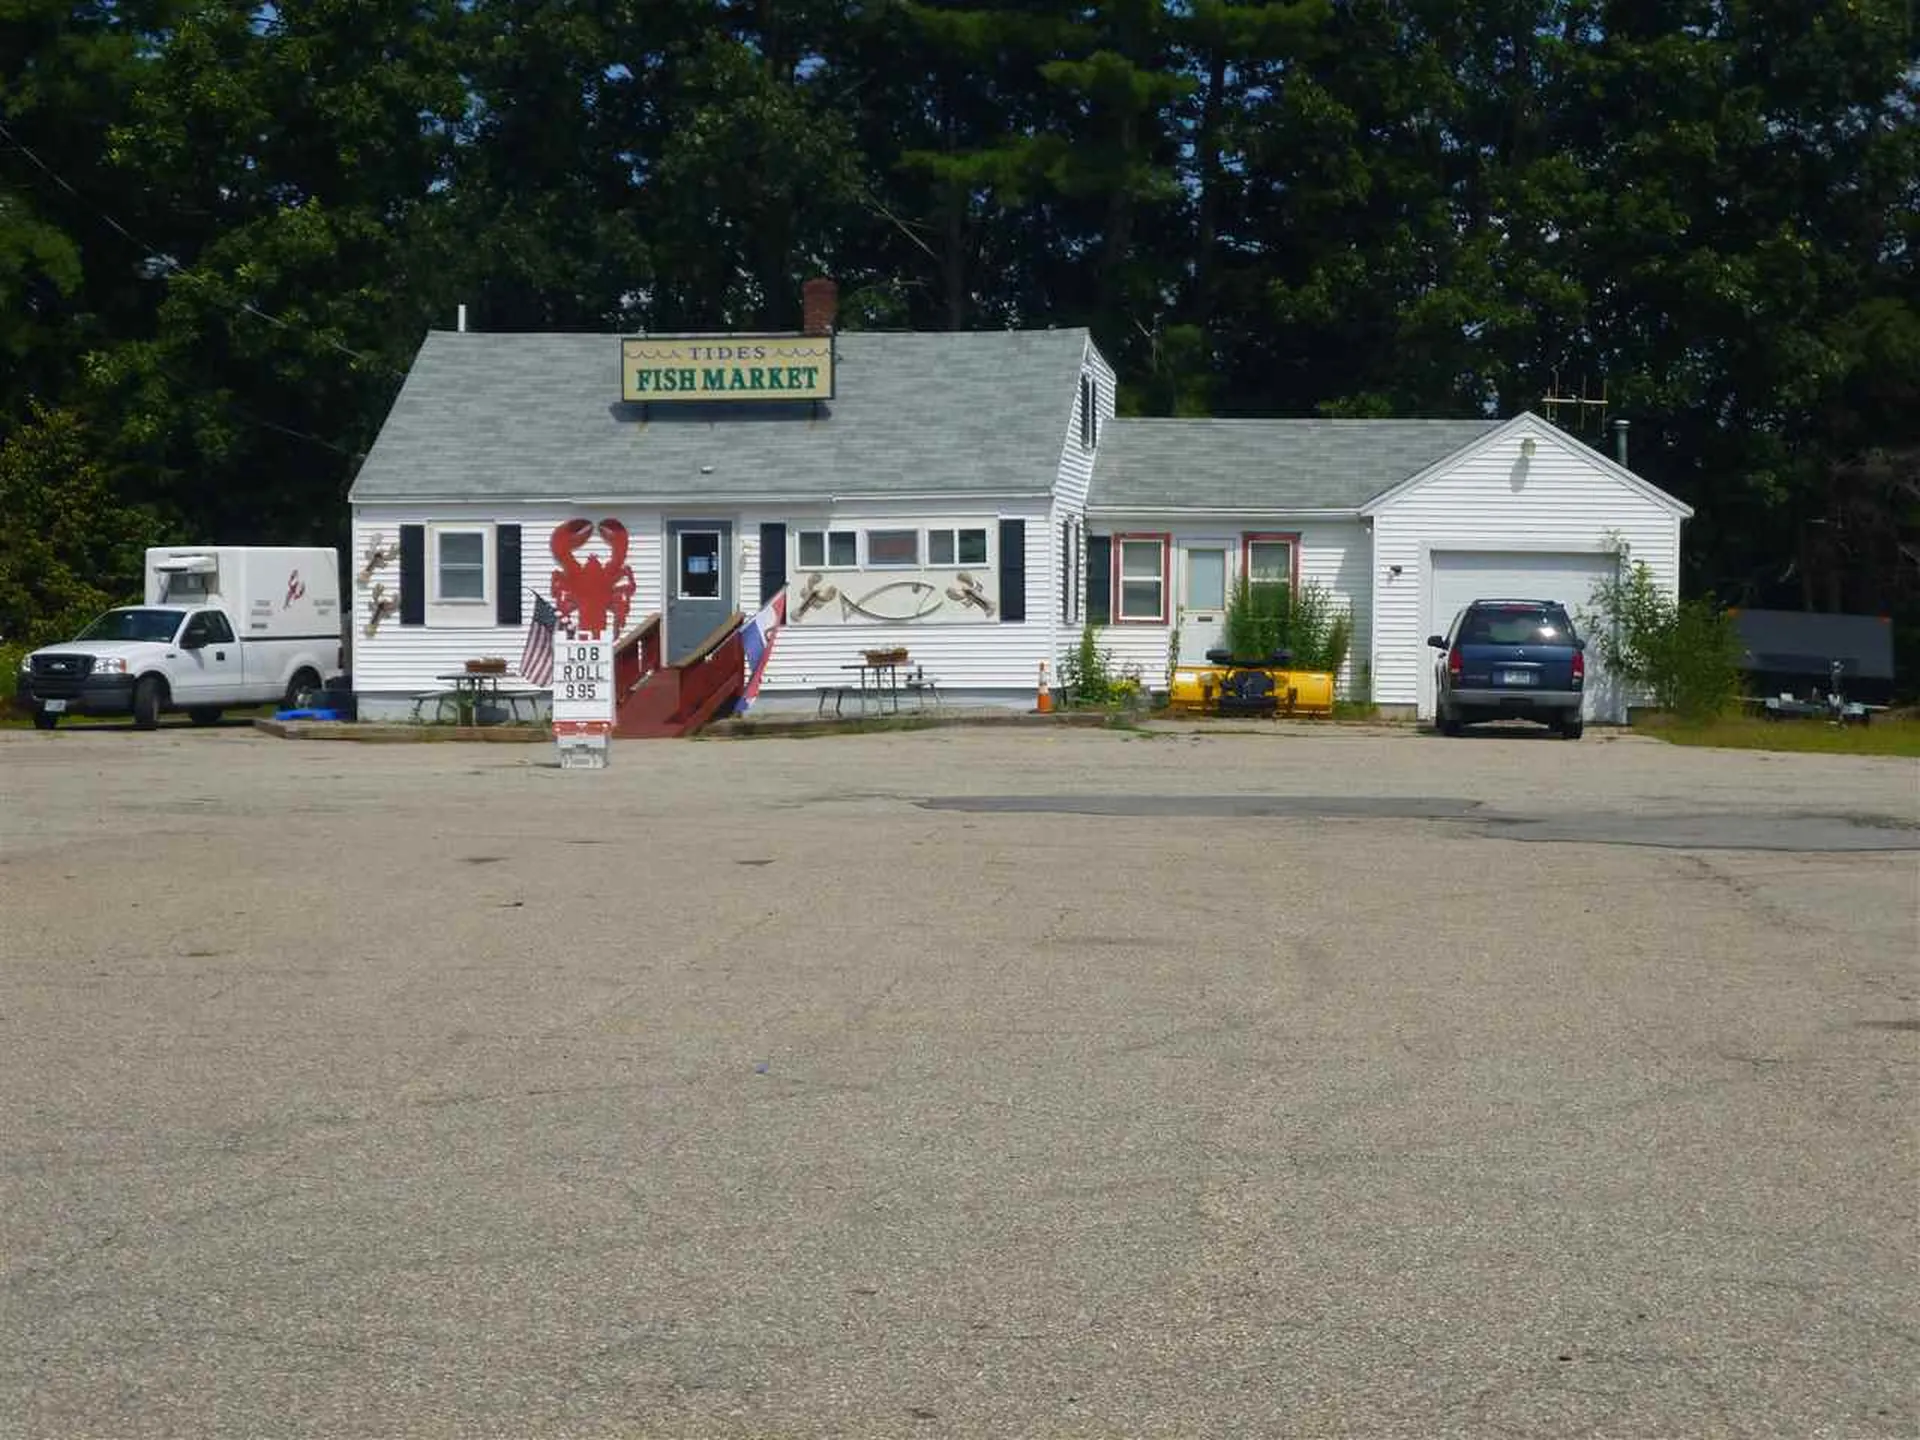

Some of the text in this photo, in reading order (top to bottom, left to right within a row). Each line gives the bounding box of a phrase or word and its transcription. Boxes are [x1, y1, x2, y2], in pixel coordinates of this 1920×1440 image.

[688, 346, 767, 361] TIDES
[636, 367, 819, 392] FISH MARKET
[564, 665, 604, 681] ROLL
